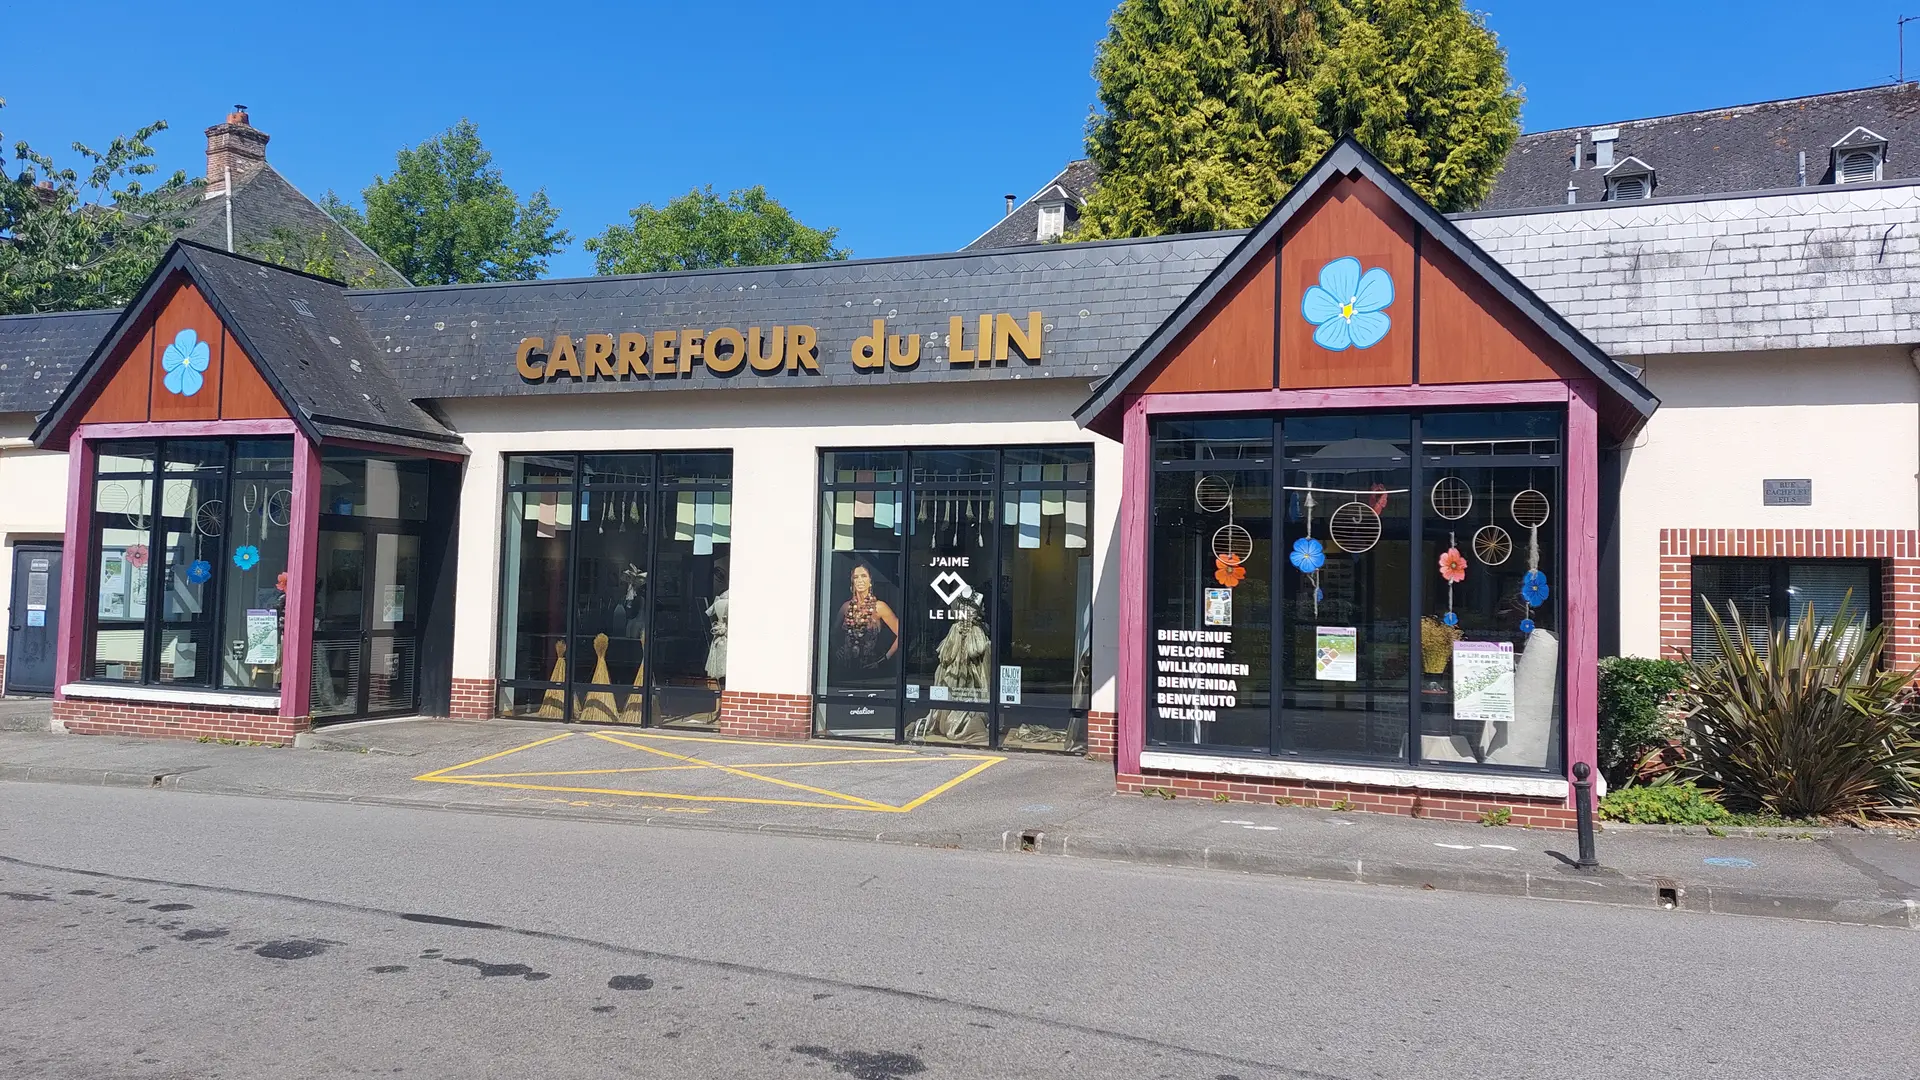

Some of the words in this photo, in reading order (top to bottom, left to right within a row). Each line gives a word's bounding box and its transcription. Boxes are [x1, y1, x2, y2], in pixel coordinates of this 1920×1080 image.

[516, 324, 820, 379] CARREFOUR
[851, 319, 920, 368] du
[950, 311, 1042, 363] LIN
[929, 556, 970, 567] J'AIME
[929, 609, 944, 620] LE
[947, 609, 968, 620] LIN
[1157, 629, 1232, 643] BIENVENUE
[1157, 644, 1225, 659] WELCOME
[1001, 667, 1020, 679] ENJOY
[1157, 660, 1250, 676] WILLKOMMEN
[1001, 685, 1020, 695] EUROPE
[1157, 676, 1238, 691] BIENVENIDA
[1157, 692, 1236, 707] BENVENUTO
[1158, 706, 1217, 722] WELKOM
